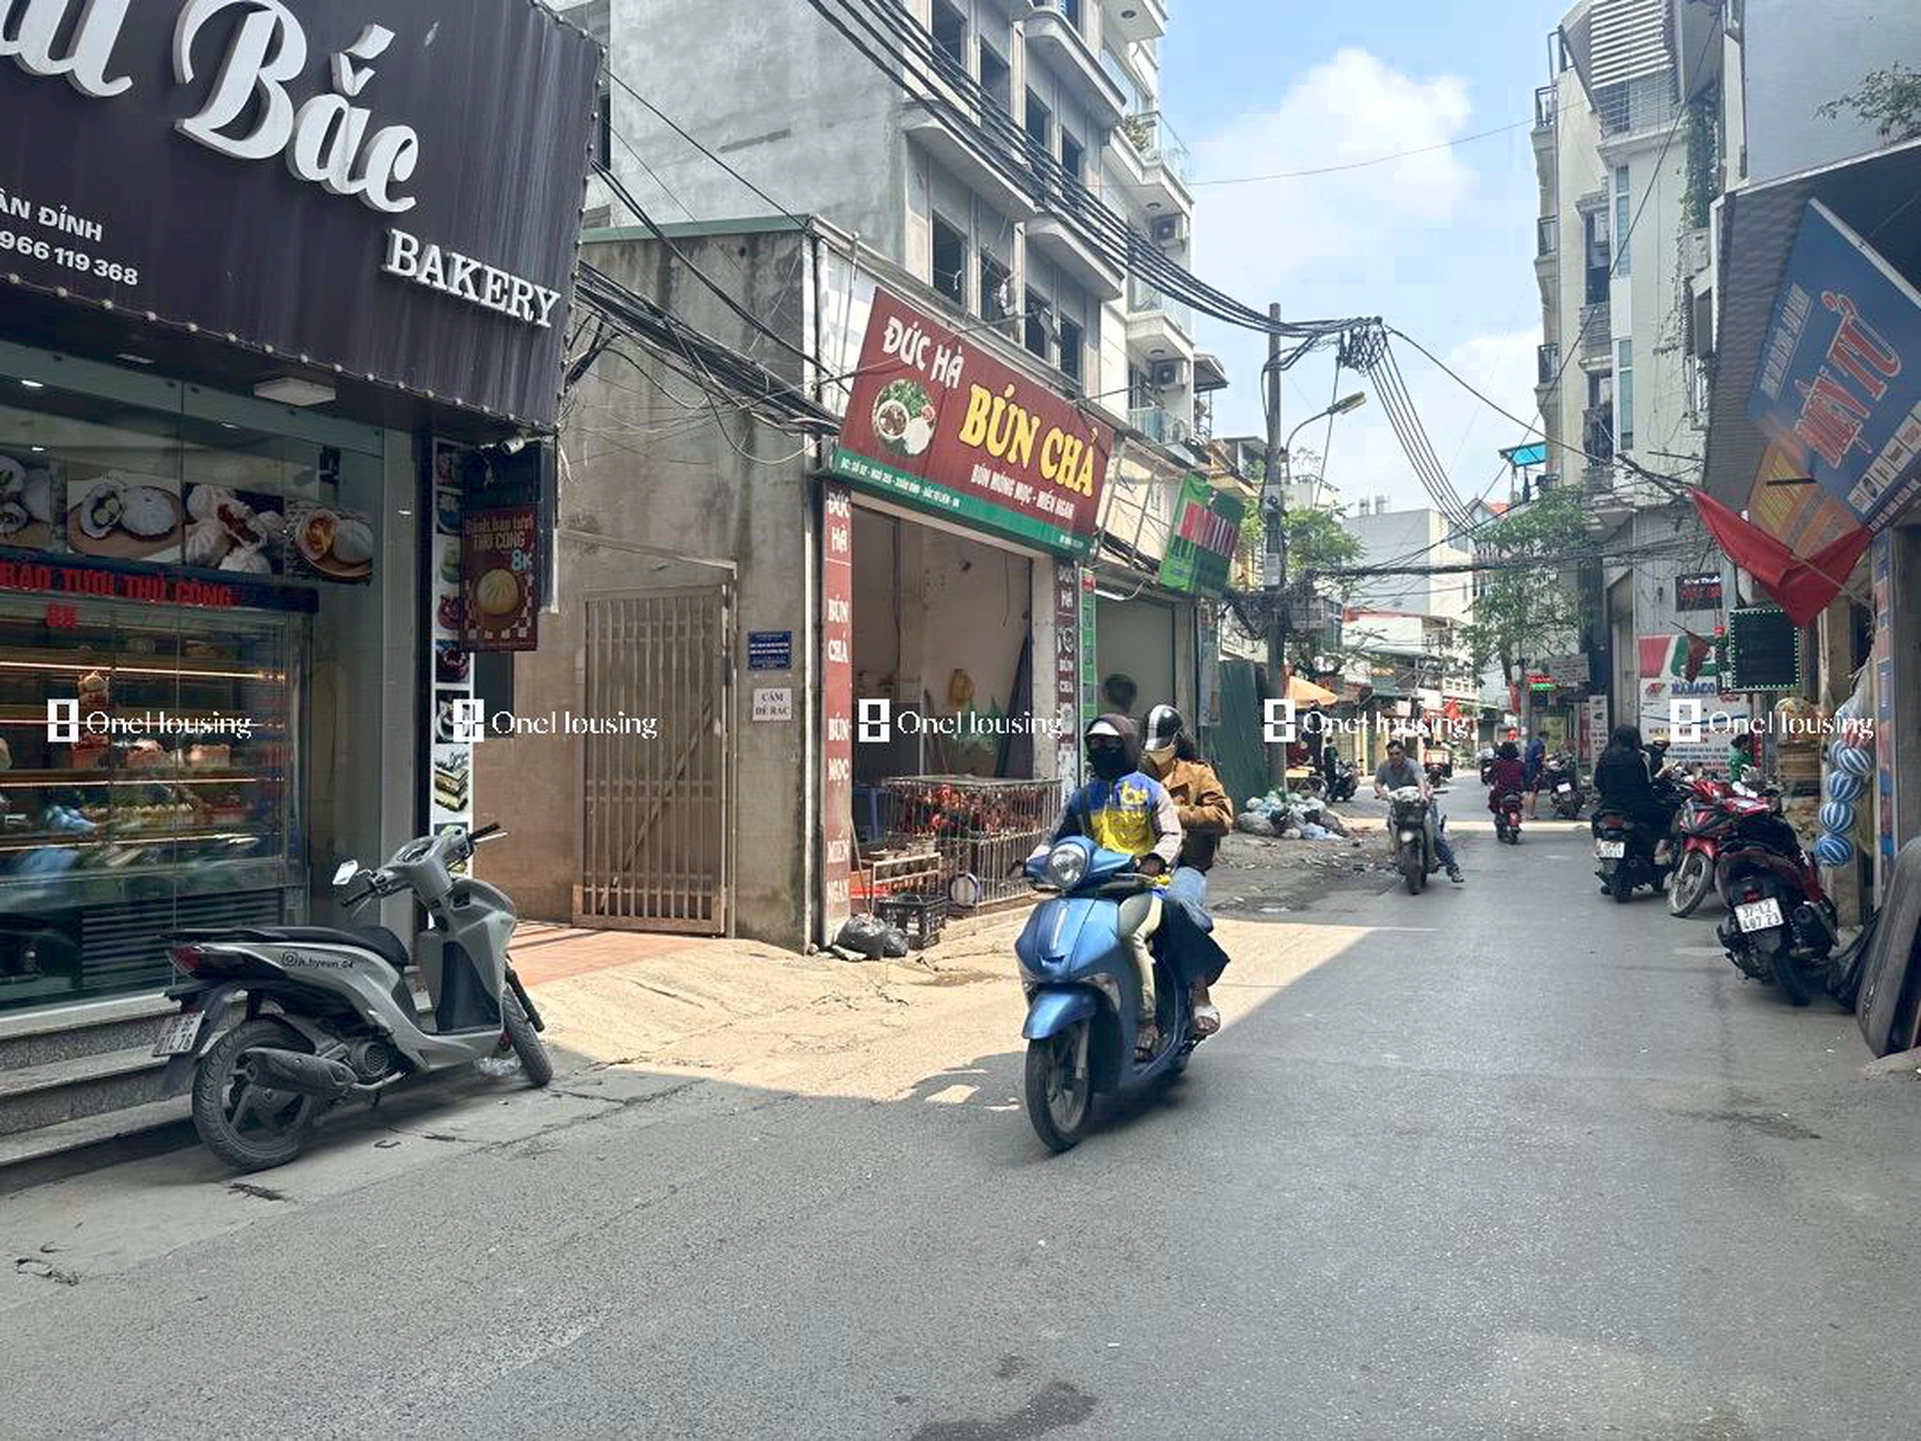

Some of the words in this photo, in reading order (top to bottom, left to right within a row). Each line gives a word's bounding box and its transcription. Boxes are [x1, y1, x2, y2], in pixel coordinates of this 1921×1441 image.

[173, 0, 420, 213] Bắc
[38, 204, 103, 242] ĐỈNH
[54, 247, 90, 271] 119
[93, 259, 139, 286] 368
[383, 228, 560, 328] BAKERY
[883, 316, 931, 371] ĐỨC
[930, 344, 964, 389] HÀ
[958, 383, 1041, 469] BÚN
[1040, 426, 1098, 497] CHẢ
[971, 463, 992, 488] BÚN
[1036, 489, 1057, 513] MIẾN
[831, 524, 848, 553] HÀ
[828, 594, 849, 623] BÚN
[828, 712, 850, 741] BÚN
